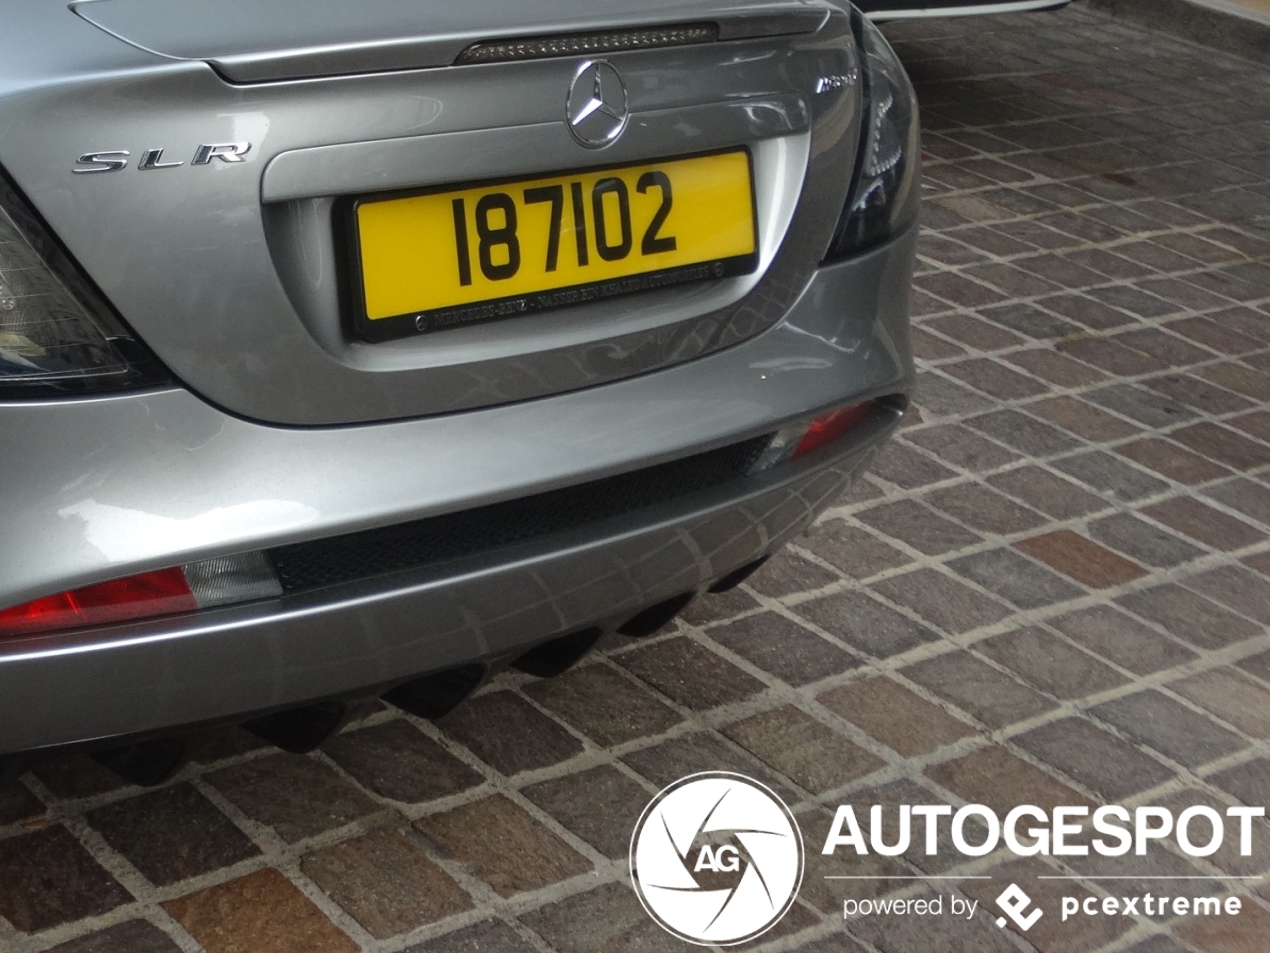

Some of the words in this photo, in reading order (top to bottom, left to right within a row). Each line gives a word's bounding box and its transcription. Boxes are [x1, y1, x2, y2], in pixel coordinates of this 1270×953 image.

[71, 141, 252, 174] SLR
[451, 170, 677, 287] 187102
[435, 298, 527, 327] MERCEDES-BENZ
